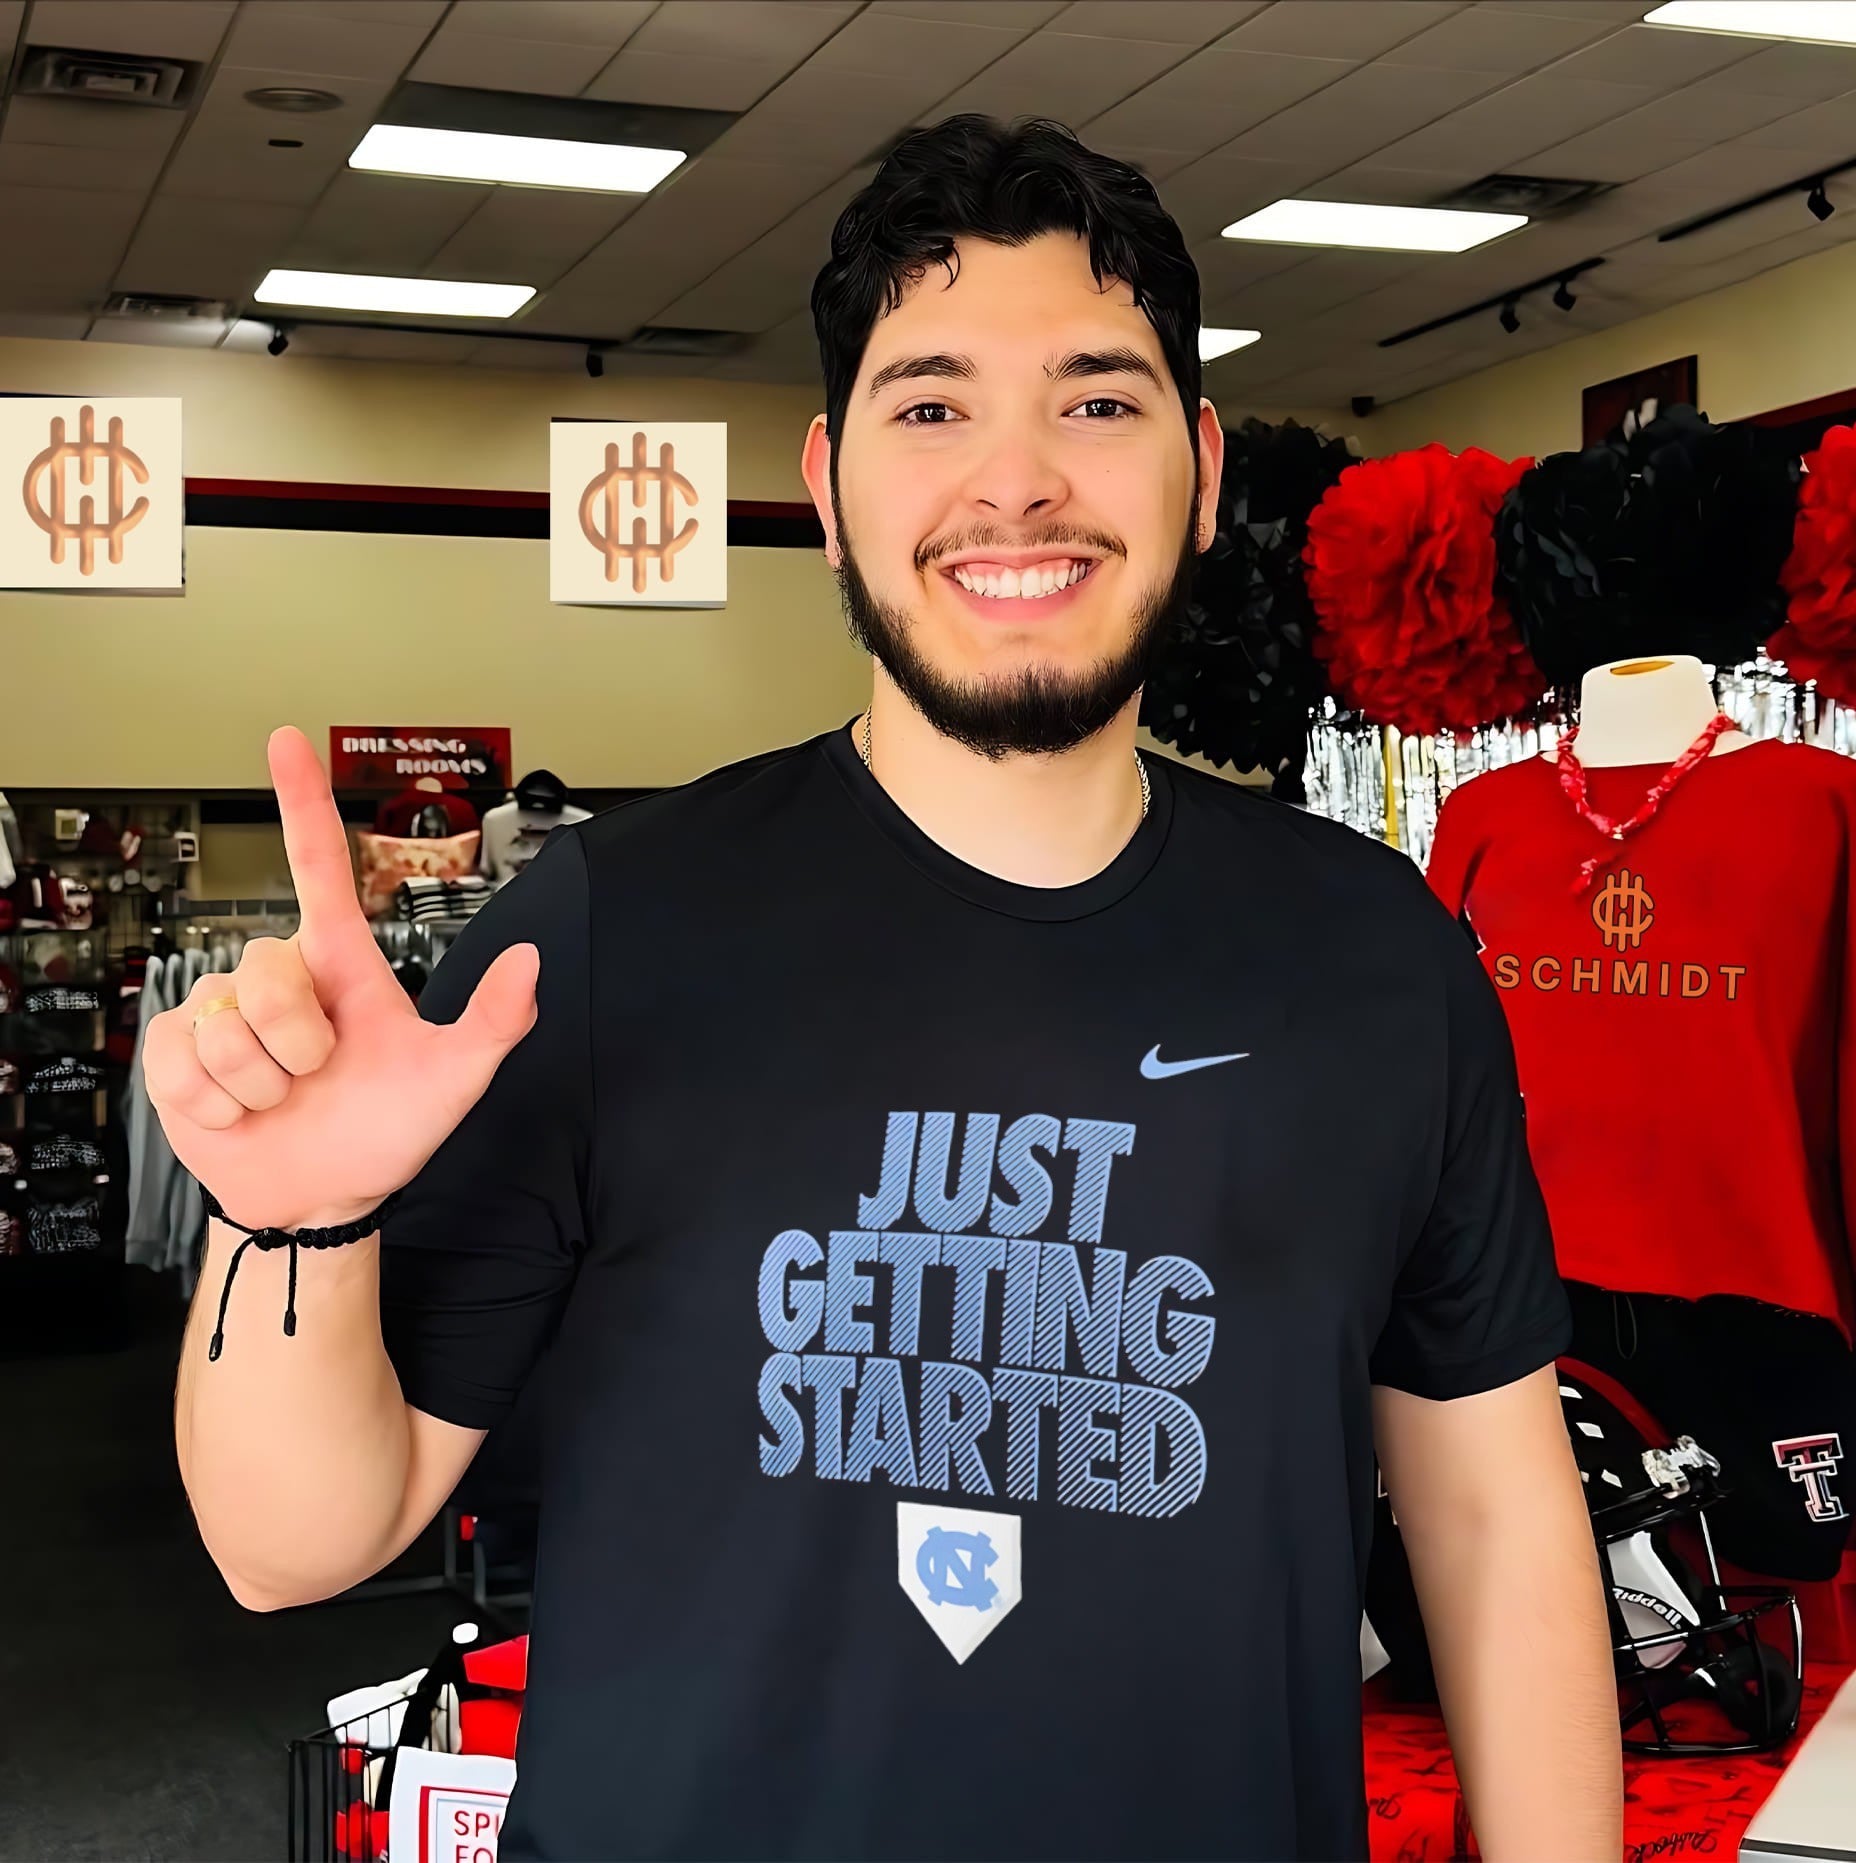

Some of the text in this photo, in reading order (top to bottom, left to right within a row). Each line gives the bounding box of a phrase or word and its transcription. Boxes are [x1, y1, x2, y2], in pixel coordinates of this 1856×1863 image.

[396, 758, 487, 775] ROOMS
[1494, 954, 1746, 1000] SCHMIDT
[857, 1111, 1136, 1244] JUST
[758, 1229, 1216, 1389] GETTING
[758, 1352, 1208, 1518] STARTED
